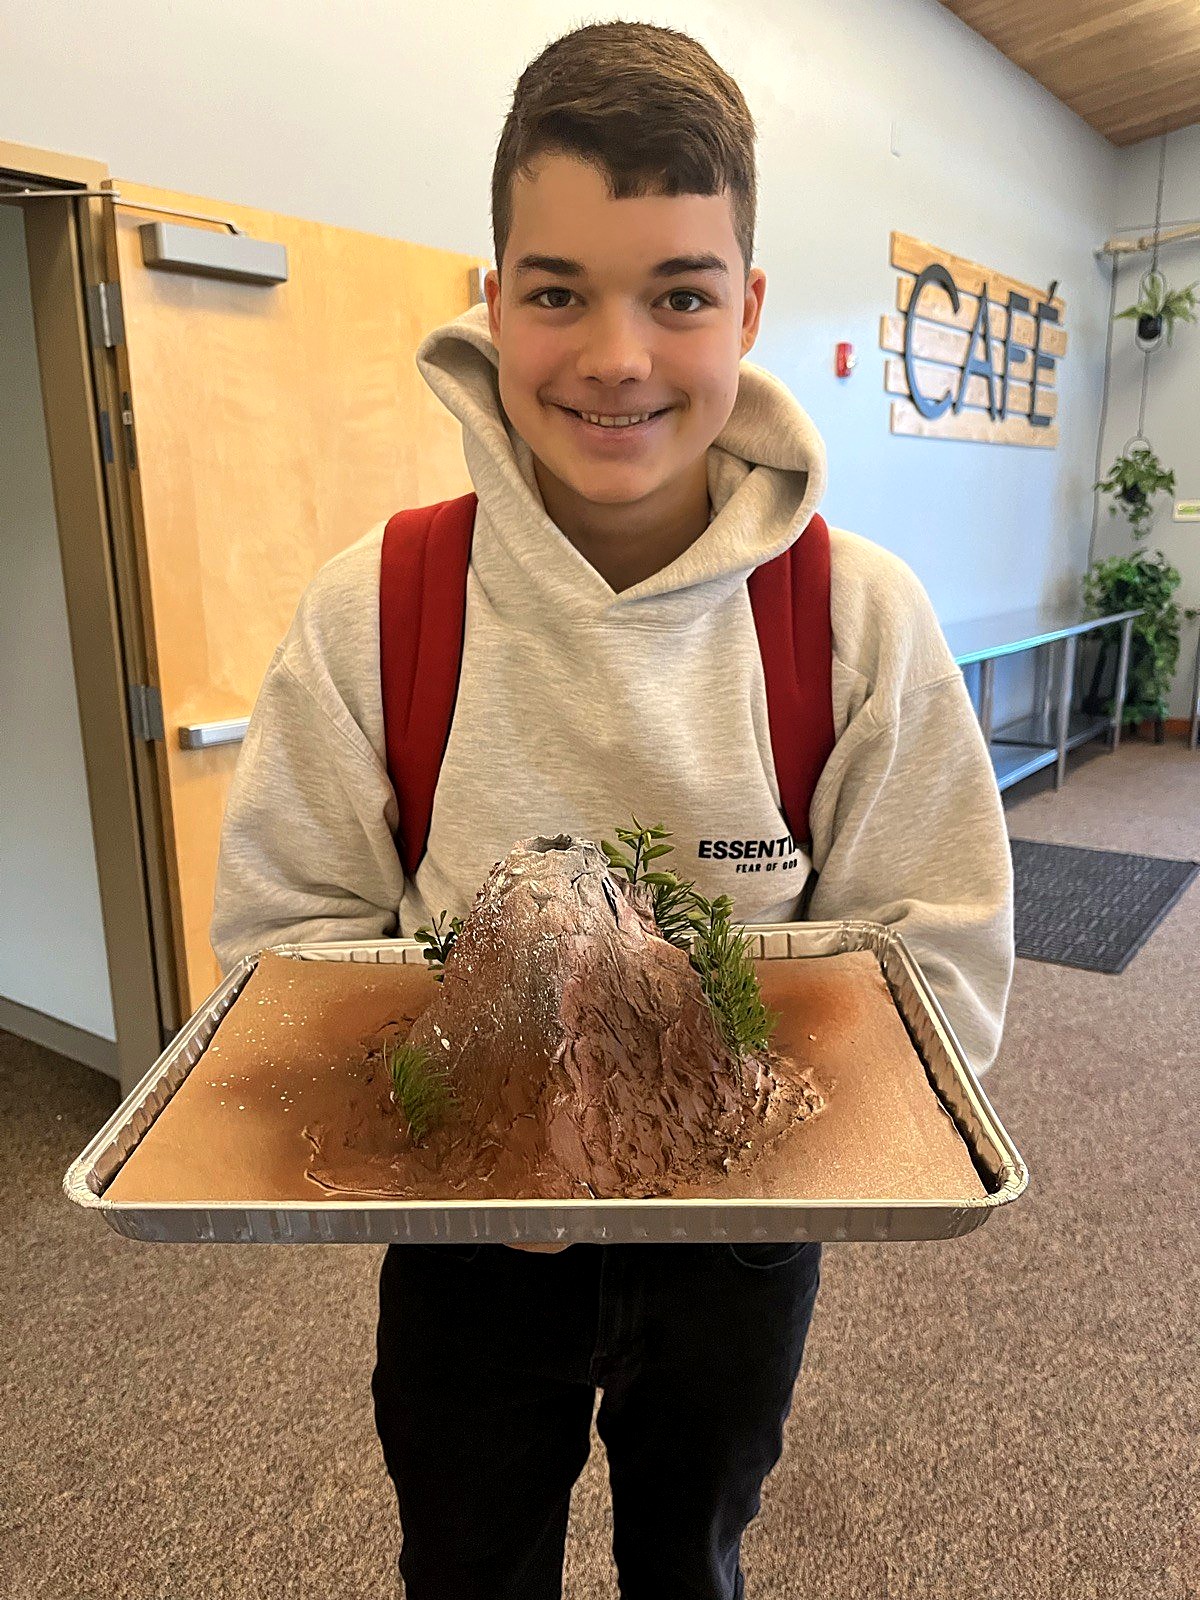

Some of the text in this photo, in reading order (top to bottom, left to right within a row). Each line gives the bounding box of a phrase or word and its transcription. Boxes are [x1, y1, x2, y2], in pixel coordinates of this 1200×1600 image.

[904, 264, 1058, 427] CAFÉ
[698, 836, 795, 859] ESSENTI
[736, 864, 761, 873] FEAR
[766, 862, 778, 872] OF
